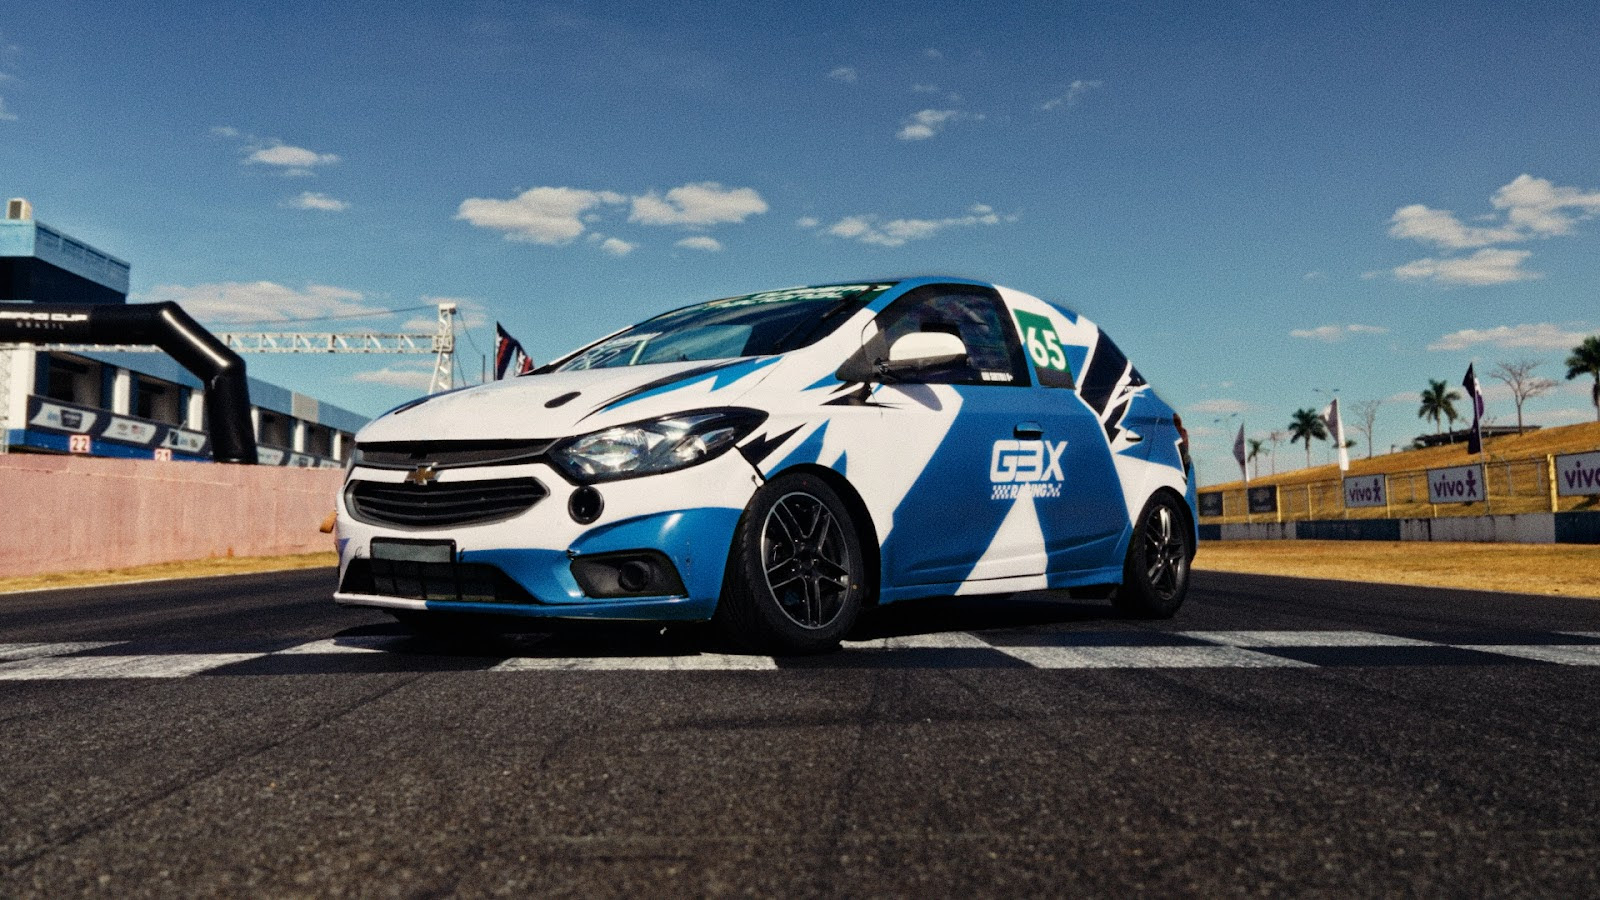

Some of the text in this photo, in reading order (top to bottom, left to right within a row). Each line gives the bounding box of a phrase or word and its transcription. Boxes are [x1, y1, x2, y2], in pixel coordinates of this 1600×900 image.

[1027, 326, 1066, 370] 65
[73, 437, 87, 451] 22
[1010, 483, 1048, 498] RAING
[1350, 482, 1371, 501] vivo
[1433, 473, 1464, 498] vivo
